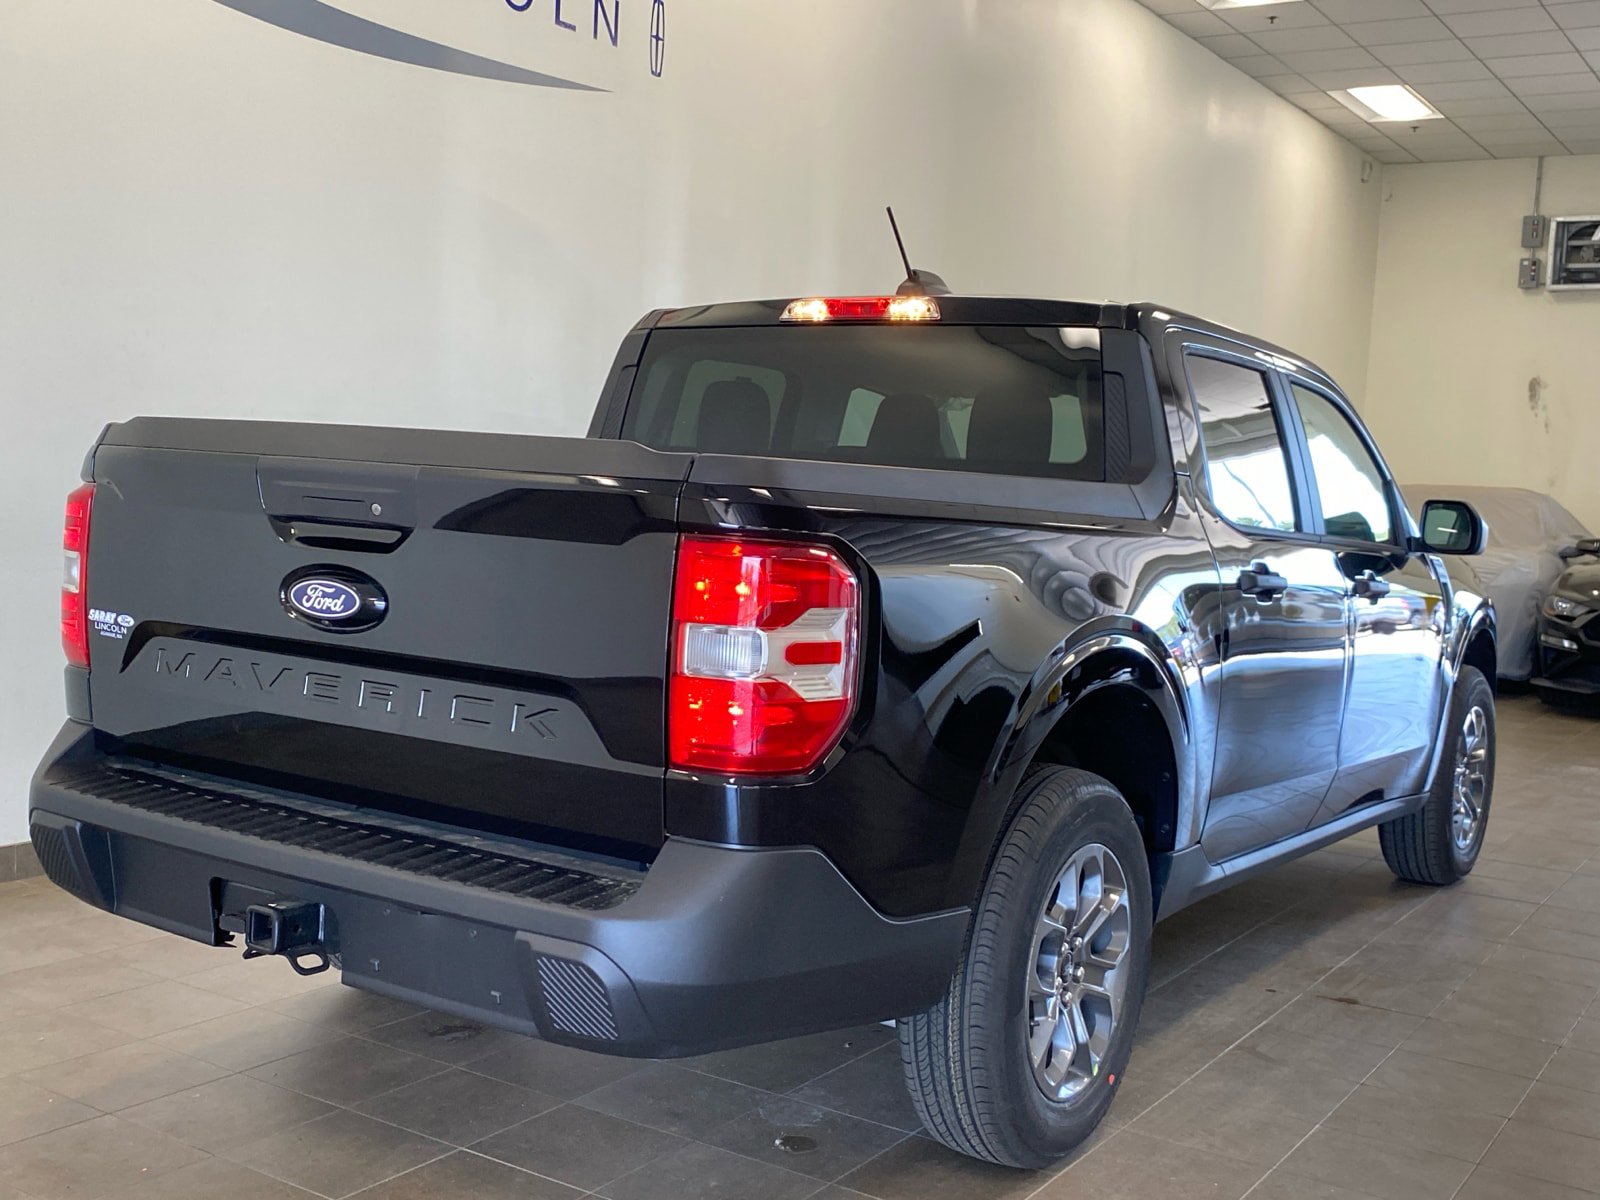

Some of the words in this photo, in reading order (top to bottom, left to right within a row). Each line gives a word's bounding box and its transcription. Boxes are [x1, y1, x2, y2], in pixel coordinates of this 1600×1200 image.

[302, 584, 346, 612] Ford
[94, 621, 127, 635] LINCOLN
[155, 648, 559, 740] MAVERICK
